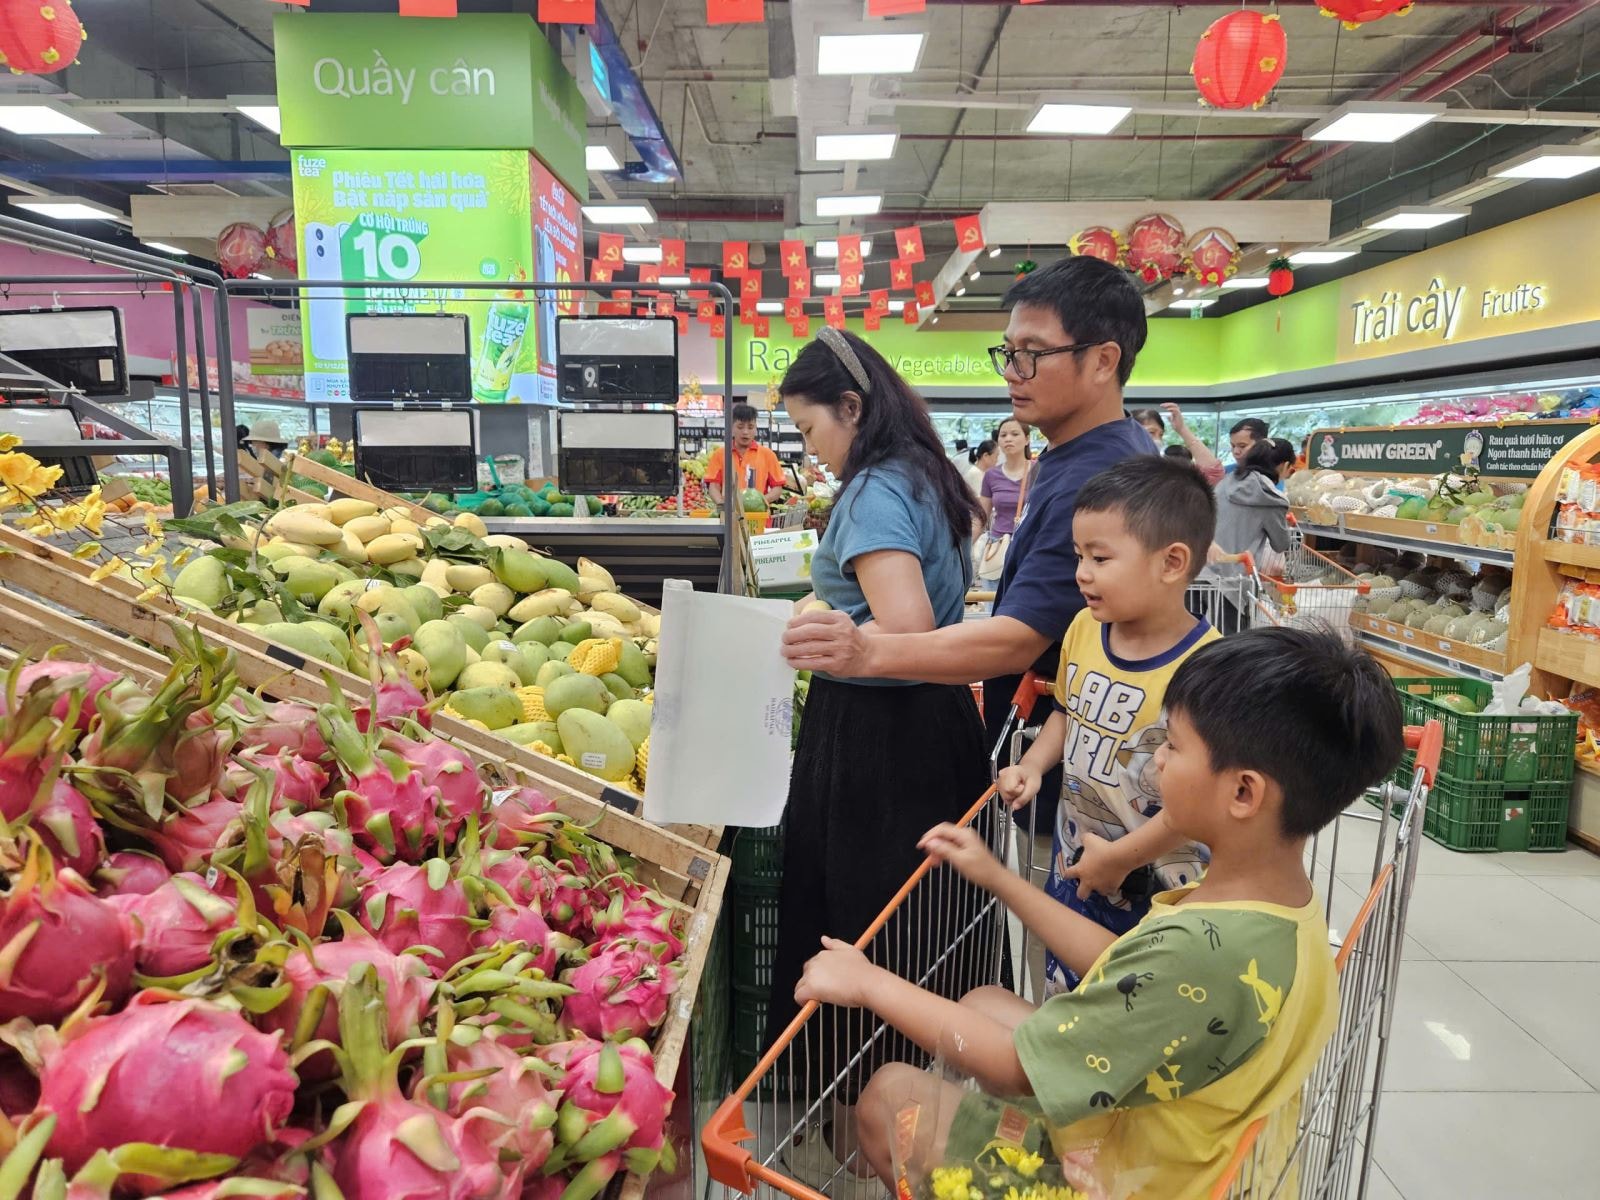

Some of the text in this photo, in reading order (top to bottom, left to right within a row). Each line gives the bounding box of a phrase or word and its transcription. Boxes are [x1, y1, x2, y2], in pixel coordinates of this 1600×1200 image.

[313, 49, 496, 105] Quầy cân
[298, 155, 326, 168] fuze
[299, 166, 321, 177] tea
[385, 170, 416, 189] Tết
[376, 213, 395, 234] HỘI
[353, 229, 421, 280] 10
[1352, 278, 1544, 344] Trái cây Fruits
[748, 340, 799, 372] Ra
[1489, 434, 1503, 446] Rau
[1341, 443, 1438, 460] DANNY GREEN
[1488, 448, 1507, 461] Ngon
[1508, 447, 1530, 459] thanh
[1509, 462, 1520, 471] theo
[754, 537, 791, 546] PINEAPPLE
[755, 555, 787, 564] PINEAPPLE
